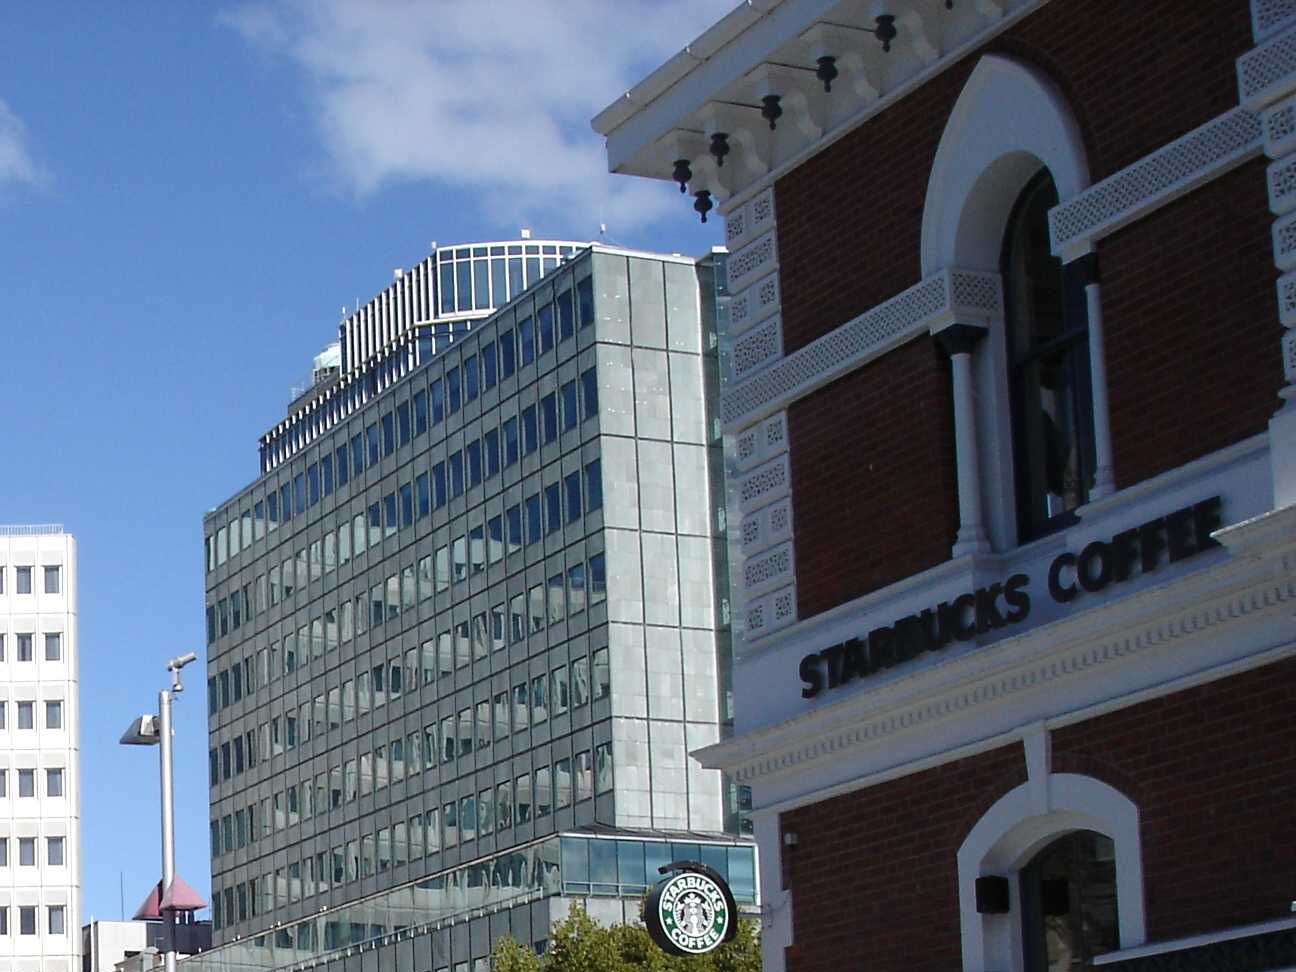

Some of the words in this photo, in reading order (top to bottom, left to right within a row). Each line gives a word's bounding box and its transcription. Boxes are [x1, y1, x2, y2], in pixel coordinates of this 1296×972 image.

[799, 573, 1031, 699] STARBUCKS
[1047, 495, 1222, 603] COFFEE
[663, 876, 724, 912] STARBUCKS
[671, 928, 719, 949] COFFEE
